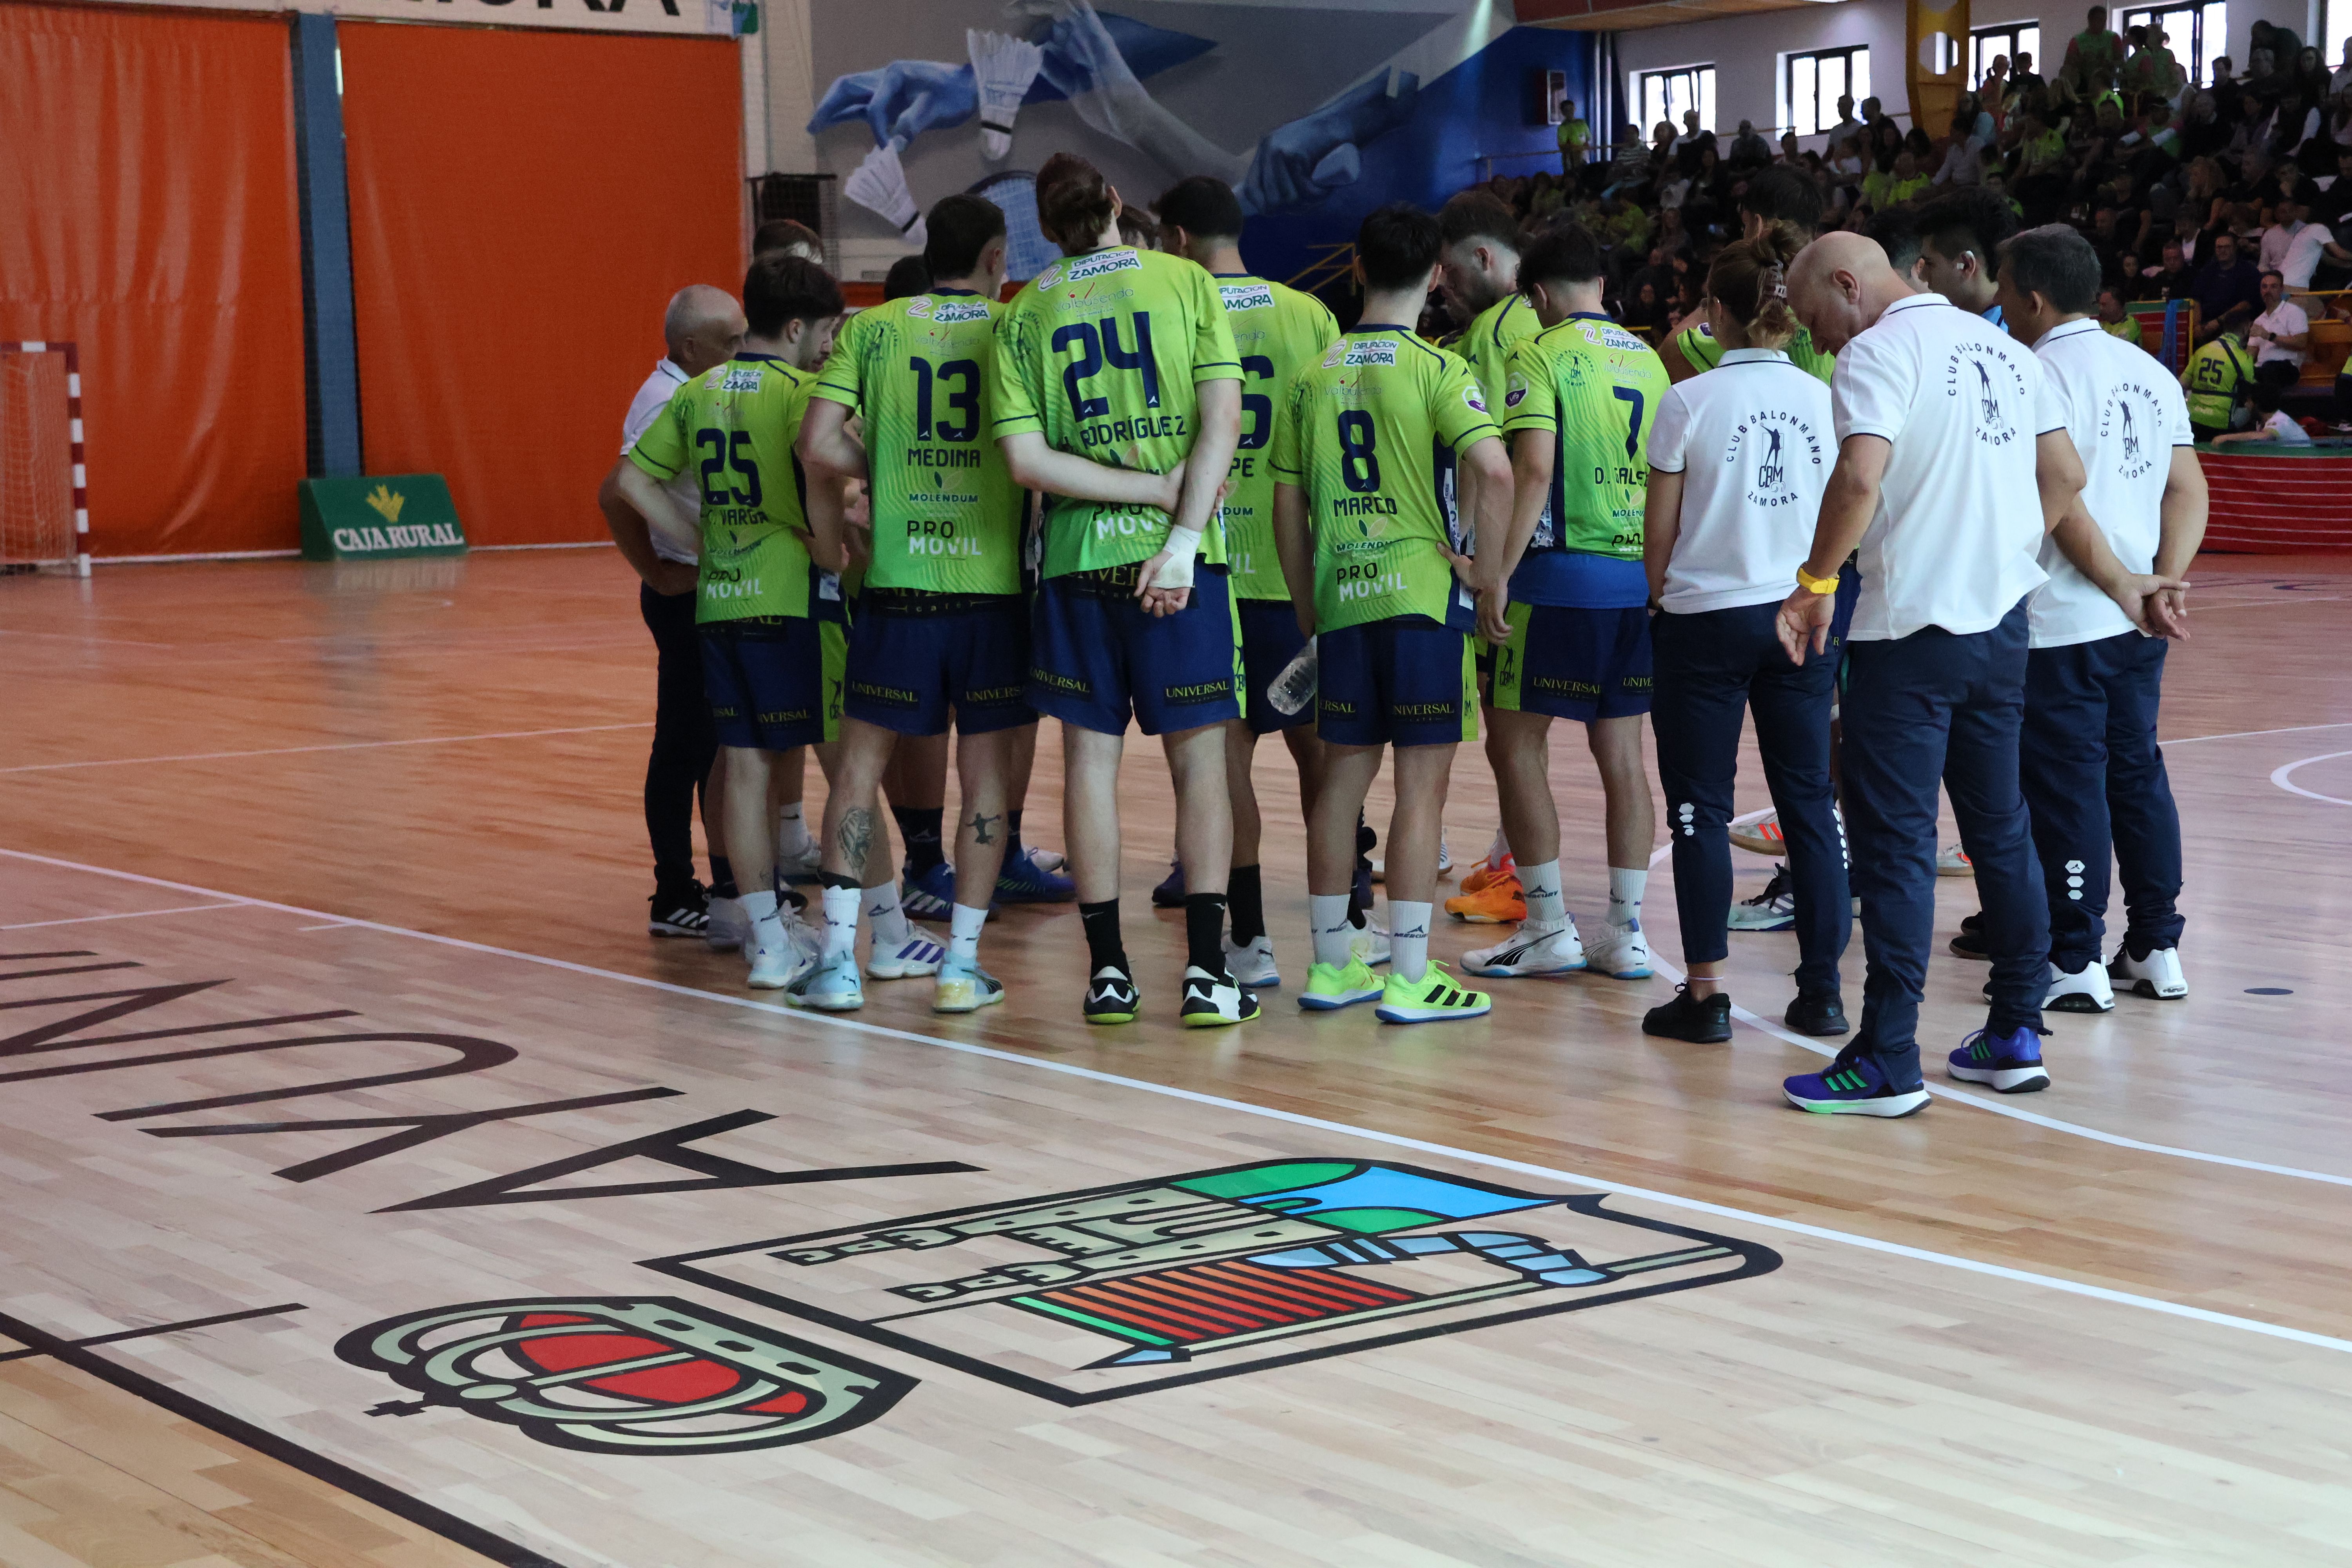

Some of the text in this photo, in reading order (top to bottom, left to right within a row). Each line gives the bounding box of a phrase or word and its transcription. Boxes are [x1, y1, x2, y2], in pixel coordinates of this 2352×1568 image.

[1069, 257, 1140, 281] ZAMORA
[935, 310, 988, 321] ZAMORA
[1603, 338, 1649, 350] ZAMORA
[1051, 311, 1160, 423] 24
[1346, 353, 1393, 365] ZAMORA
[1947, 356, 1959, 396] CLUB
[2199, 358, 2224, 385] 25
[910, 356, 980, 442] 13
[1612, 386, 1644, 463] 7
[2101, 399, 2113, 437] CLUB
[1726, 410, 1821, 464] CLUB BALONMANO
[908, 448, 980, 468] MEDINA
[1338, 410, 1381, 493] 8
[697, 428, 762, 508] 25
[1228, 457, 1255, 477] PE
[1595, 467, 1610, 485] D.
[1759, 465, 1783, 488] CBM
[909, 493, 978, 503] MOLENDUM
[1333, 497, 1397, 517] MARCO
[1748, 491, 1798, 507] ZAMORA
[334, 523, 465, 552] CAJA RURAL
[907, 520, 955, 539] PRO
[909, 537, 982, 556] MOVIL
[1337, 563, 1378, 585] PRO
[1339, 572, 1407, 602] MOVIL
[852, 681, 918, 702] UNIVERSAL
[1166, 680, 1229, 698] UNIVERSAL
[1393, 704, 1454, 715] NIVERSAL
